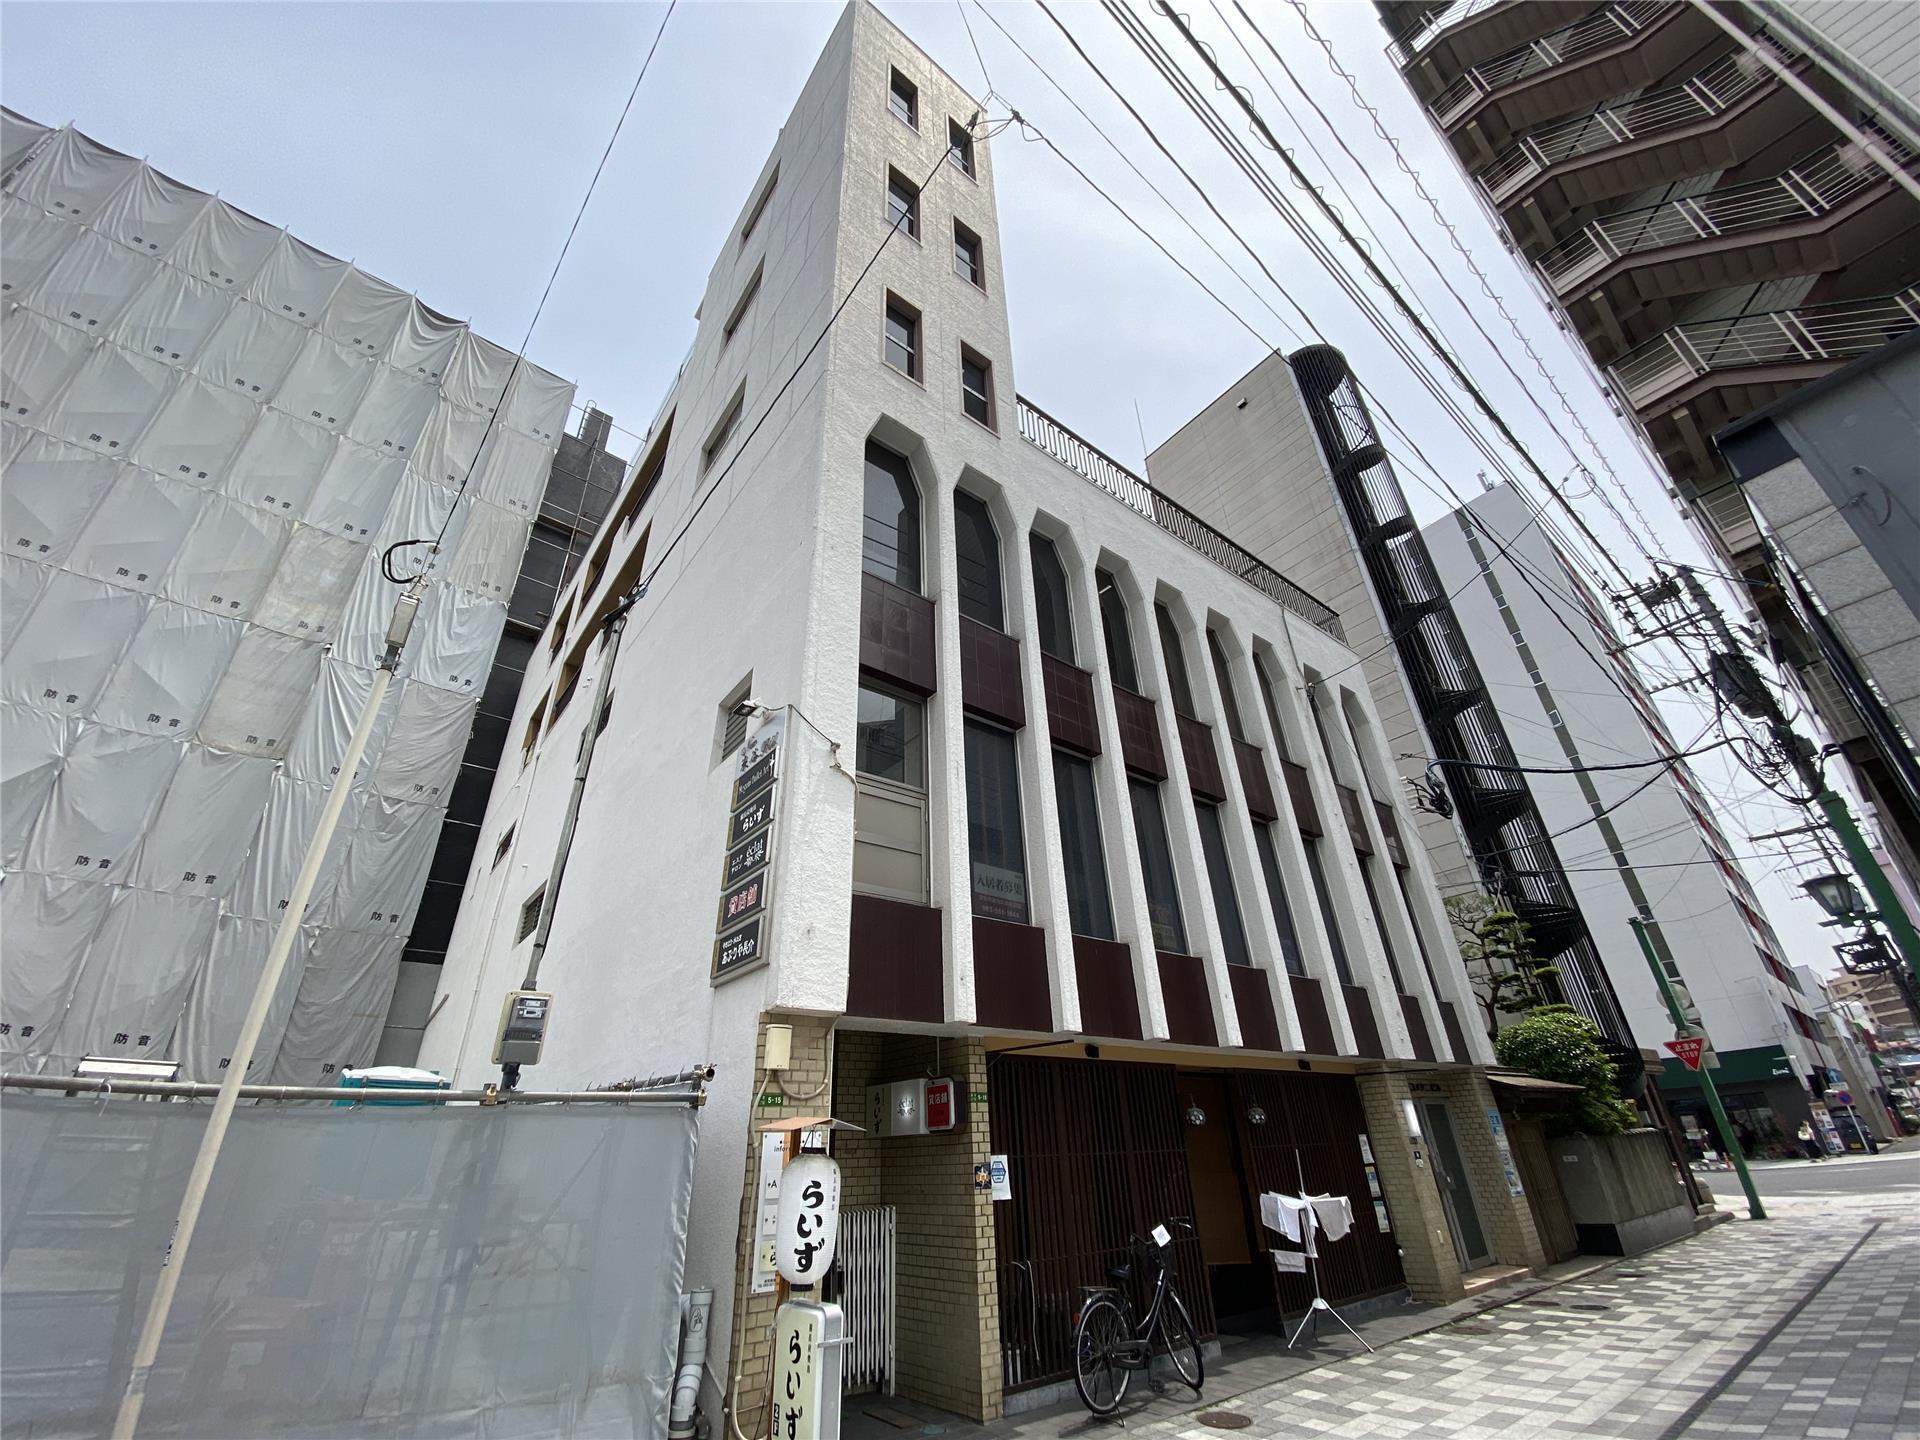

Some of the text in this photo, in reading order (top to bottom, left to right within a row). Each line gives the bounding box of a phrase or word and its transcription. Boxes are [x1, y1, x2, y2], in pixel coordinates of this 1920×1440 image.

[449, 674, 472, 687] 防音
[44, 688, 79, 704] 防音
[147, 713, 181, 727] 防音
[246, 734, 277, 748] 防音
[413, 783, 440, 795] 防音
[743, 805, 765, 832] らいず
[75, 855, 113, 870] 防音
[183, 871, 217, 885] 防音
[371, 911, 399, 923] 防音
[113, 1033, 151, 1046] 防音
[1675, 1042, 1699, 1051] 止まれ
[1681, 1051, 1698, 1059] STOP
[767, 1096, 782, 1104] 5-15
[794, 1180, 825, 1273] らいず
[786, 1329, 803, 1440] らいず
